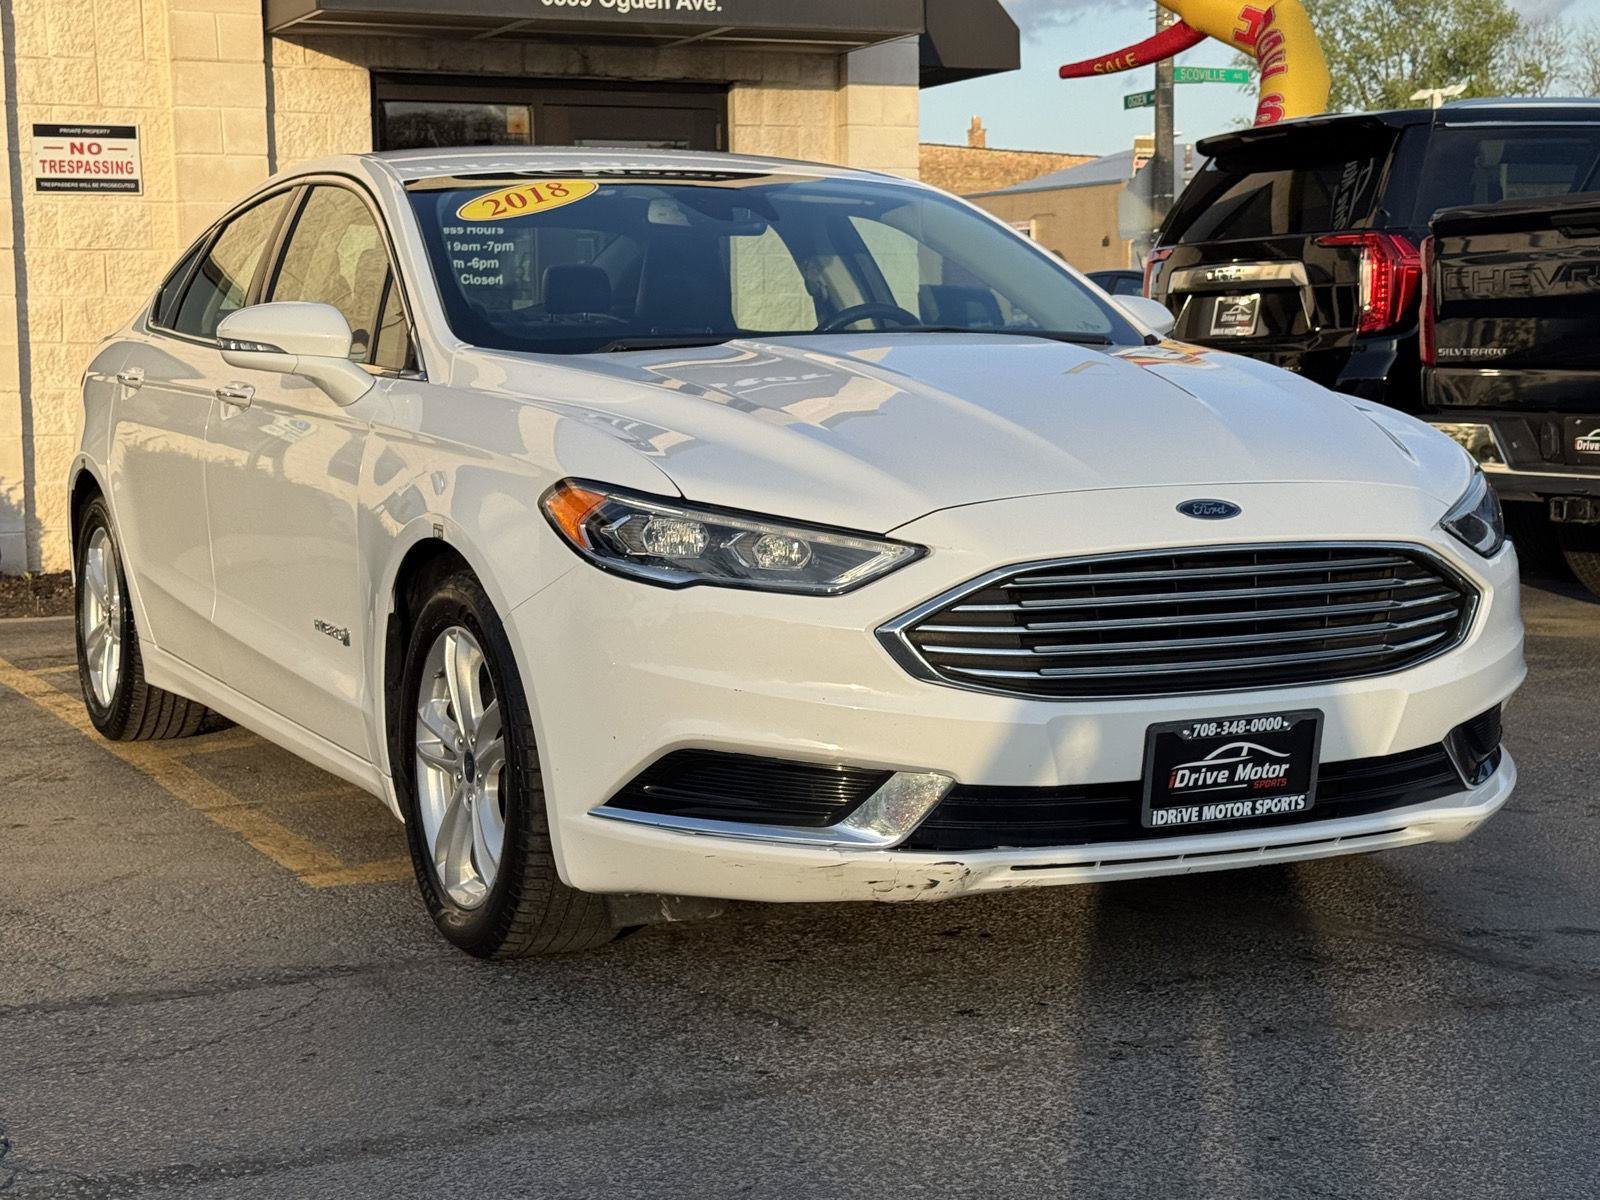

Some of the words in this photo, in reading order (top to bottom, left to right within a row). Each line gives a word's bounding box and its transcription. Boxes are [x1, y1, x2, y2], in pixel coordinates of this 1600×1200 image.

[675, 0, 722, 11] Ave.
[1093, 52, 1138, 73] SALE
[1180, 67, 1227, 81] SCOVILLE
[69, 142, 102, 155] NO
[39, 160, 134, 175] TRESPASSING
[482, 182, 570, 216] 2018
[453, 241, 481, 252] 9am
[461, 274, 503, 285] Closed
[1438, 347, 1507, 356] SILVERADO
[1193, 502, 1227, 515] Ford
[1193, 716, 1282, 737] 708-348-0000
[1168, 767, 1229, 789] iDrive
[1234, 762, 1290, 783] Motor
[1253, 778, 1287, 789] SPORTS
[1202, 802, 1252, 821] MOTOR
[1255, 794, 1306, 815] SPORTS
